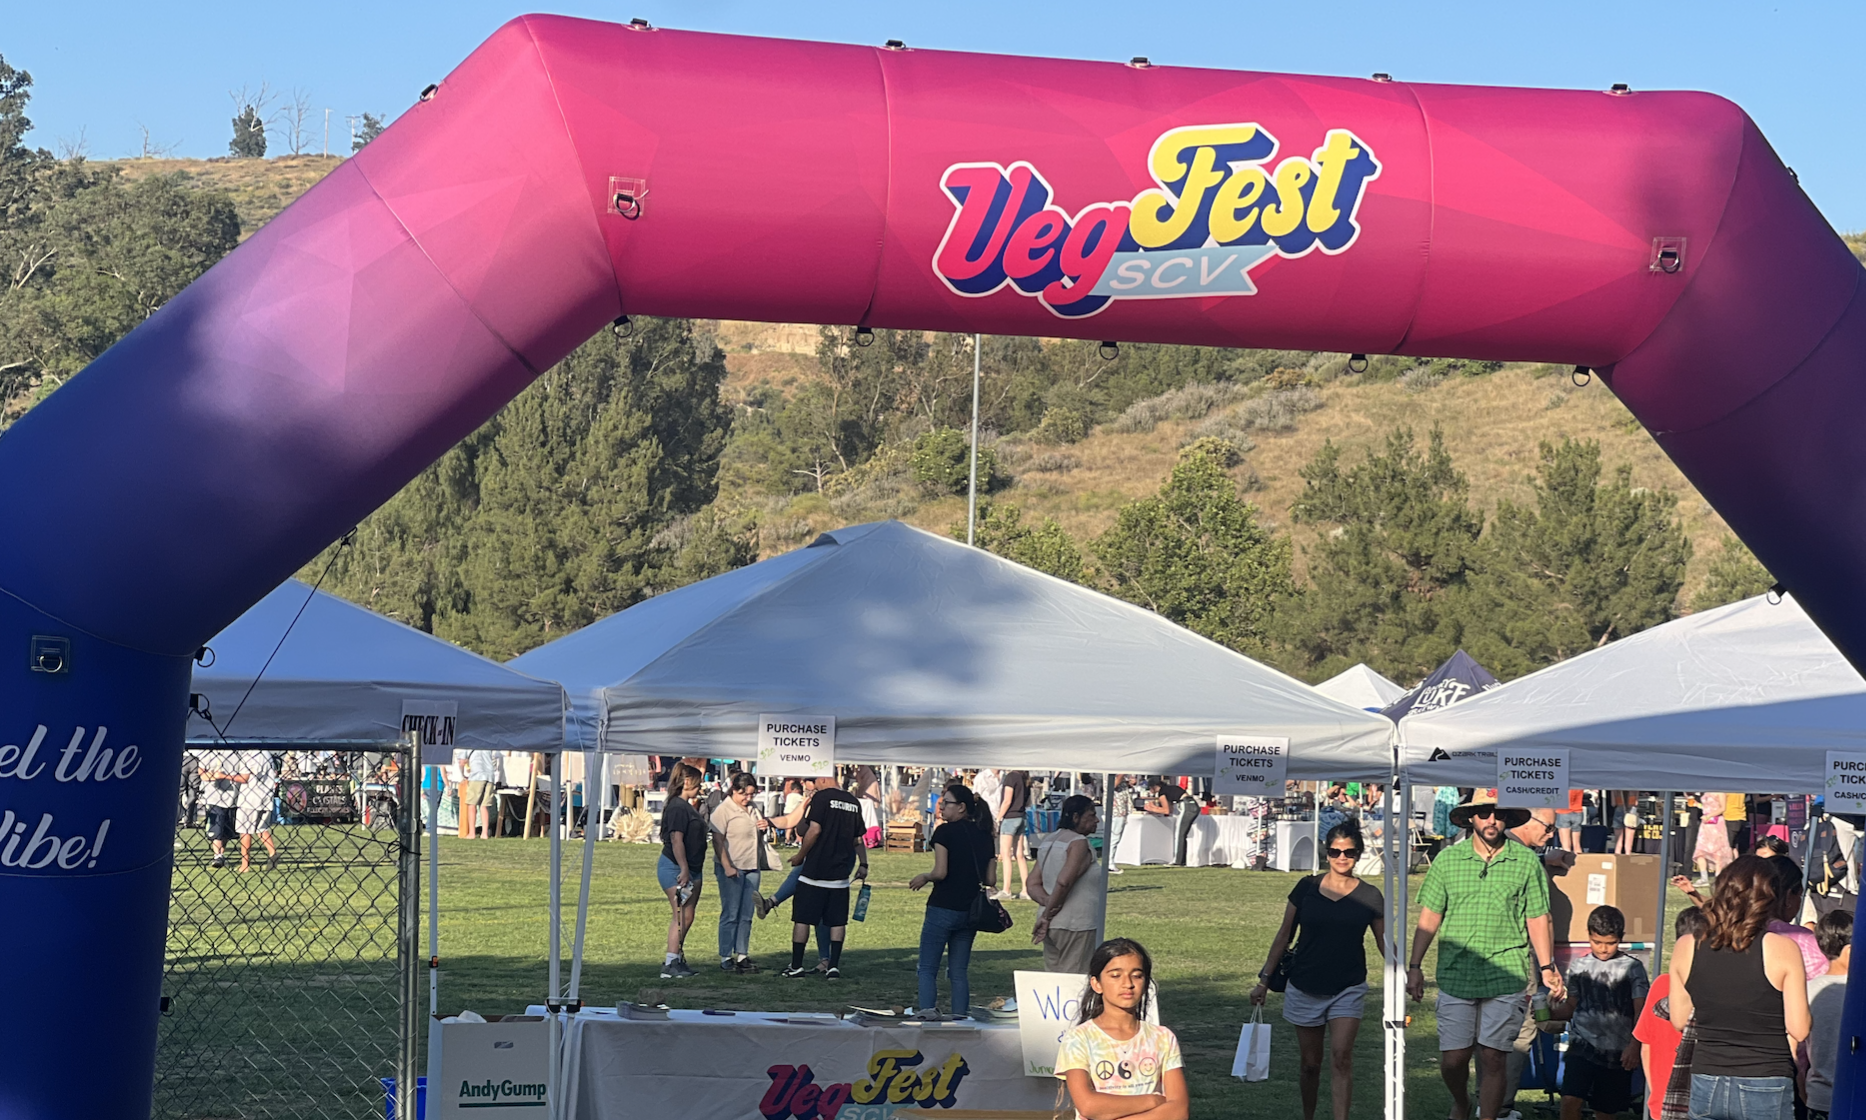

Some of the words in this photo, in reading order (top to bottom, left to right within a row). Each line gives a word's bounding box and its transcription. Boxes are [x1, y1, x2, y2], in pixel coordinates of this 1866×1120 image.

[1109, 254, 1238, 290] SCV
[766, 723, 827, 735] PURCHASE
[773, 737, 820, 747] TICKETS
[55, 726, 142, 782] the
[1224, 744, 1281, 755] PURCHASE
[780, 754, 811, 762] VENMO
[1229, 758, 1273, 767] TICKETS
[1504, 757, 1562, 767] PURCHASE
[1833, 760, 1866, 771] PURC
[1235, 774, 1265, 782] VENMO
[1511, 770, 1555, 780] TICKETS
[1505, 786, 1560, 795] CASH/CREDIT
[830, 799, 859, 813] SECURITY
